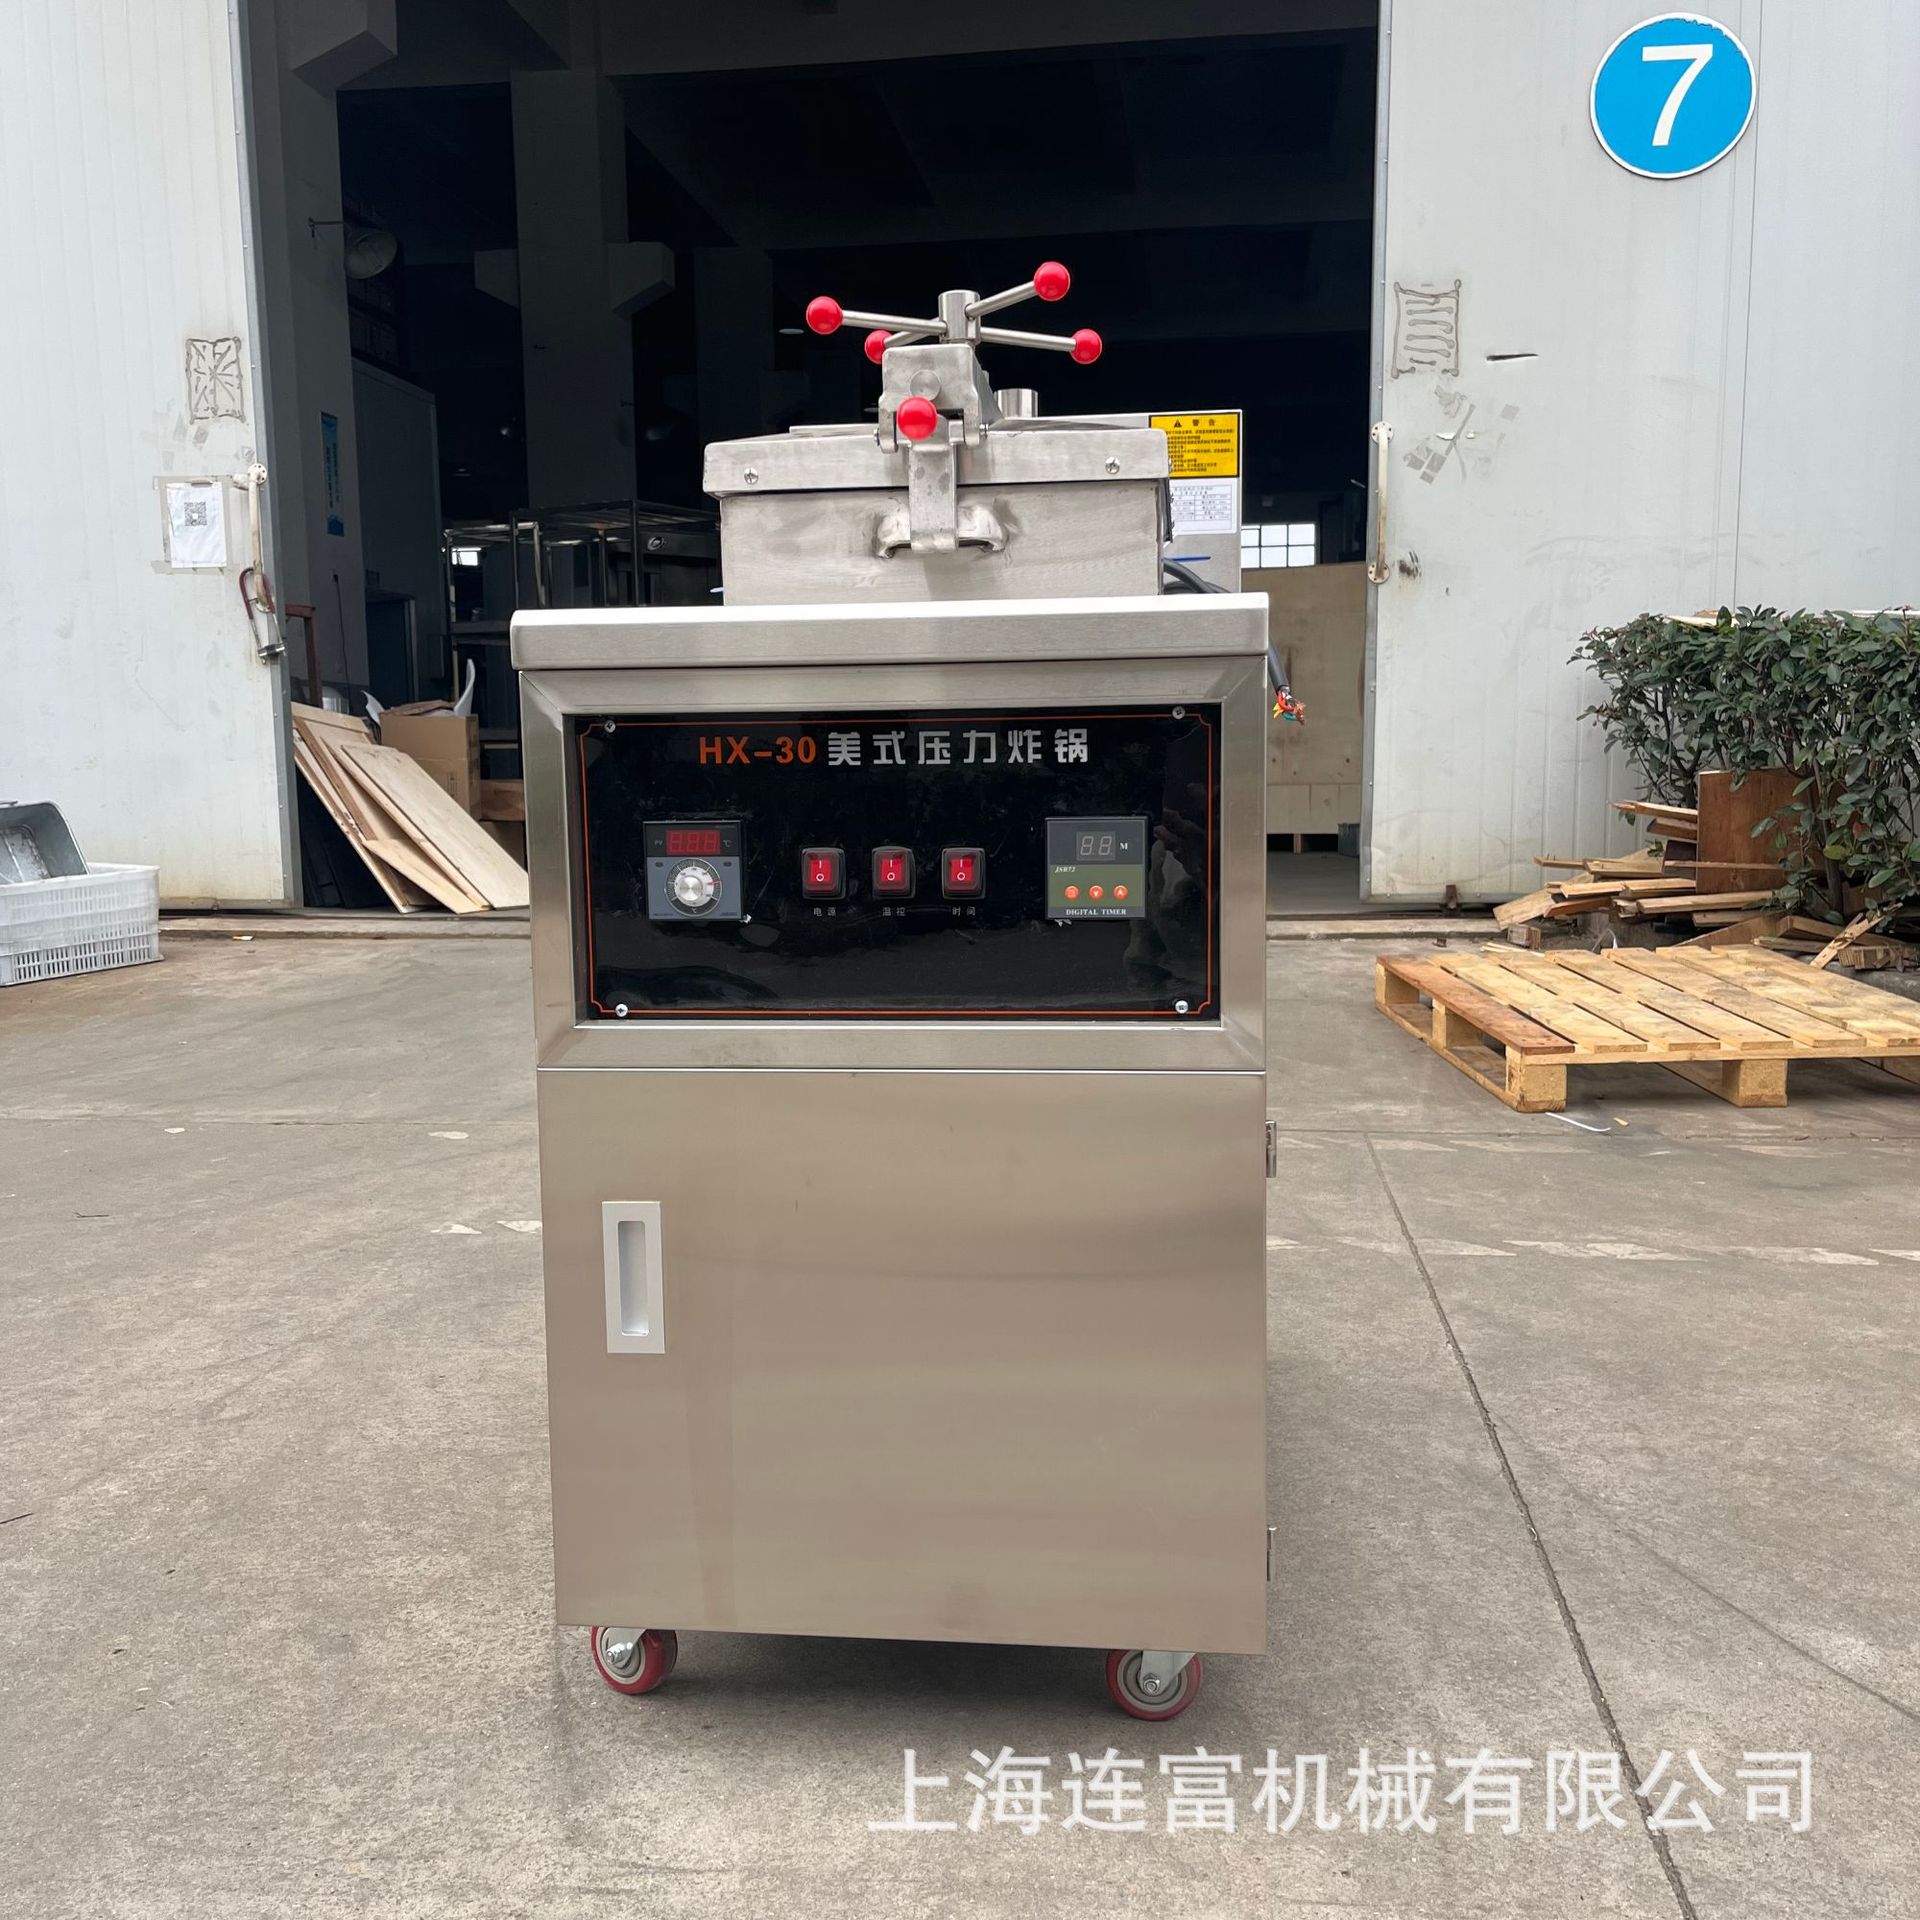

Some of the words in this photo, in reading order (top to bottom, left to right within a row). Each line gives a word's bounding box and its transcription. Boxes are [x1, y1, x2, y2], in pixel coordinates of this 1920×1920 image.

[1642, 43, 1714, 147] 7
[700, 735, 816, 764] HX-30
[827, 728, 1089, 766] 美式压力炸锅
[813, 906, 836, 917] 电源
[952, 906, 976, 916] 时间
[1065, 908, 1098, 916] DIGITAL
[1102, 908, 1127, 916] TIMER
